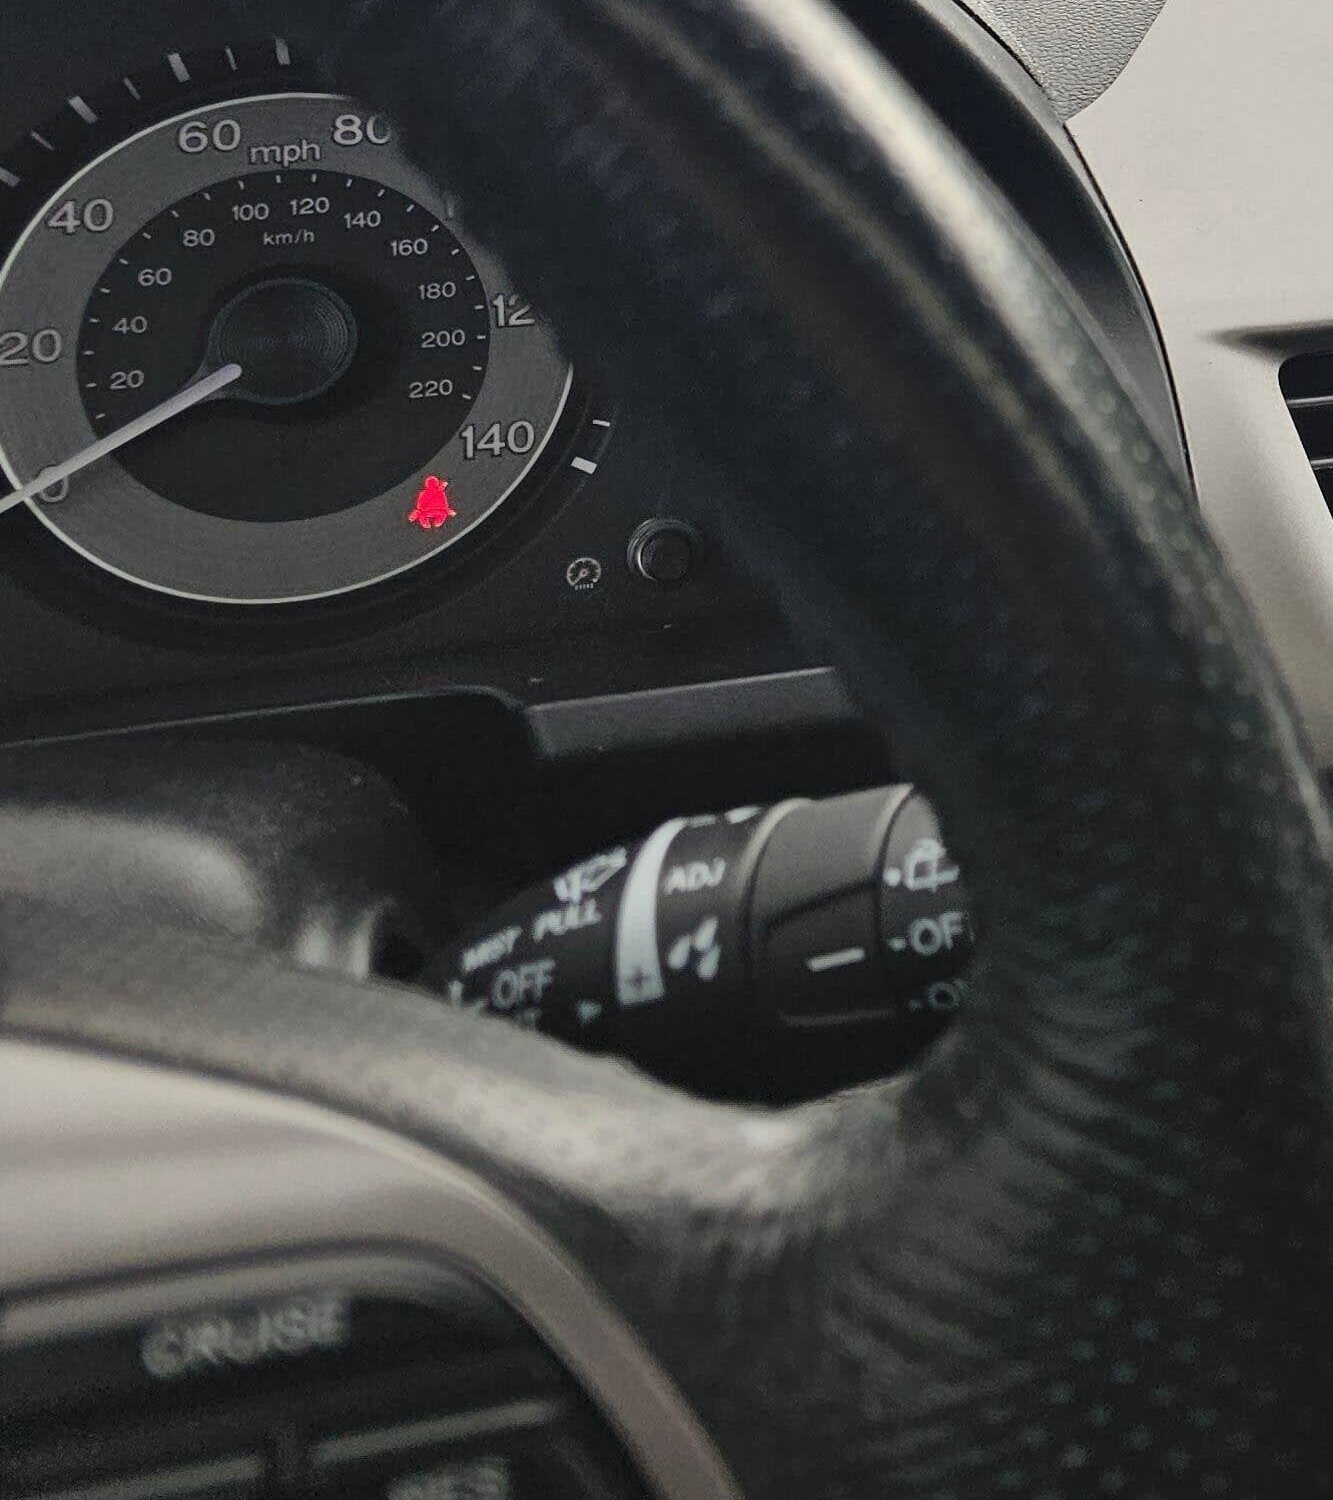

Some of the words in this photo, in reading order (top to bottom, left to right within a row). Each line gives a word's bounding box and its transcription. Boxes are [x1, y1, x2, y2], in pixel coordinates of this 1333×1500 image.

[178, 119, 242, 153] 60
[332, 113, 392, 146] 80
[249, 139, 322, 167] mph
[47, 198, 114, 233] 40
[231, 203, 270, 221] 100
[290, 196, 330, 215] 120
[343, 210, 381, 229] 140
[182, 228, 215, 247] 80
[263, 228, 315, 246] km/h
[390, 238, 428, 257] 160
[138, 267, 173, 286] 60
[417, 281, 456, 300] 180
[492, 293, 536, 327] 12
[112, 315, 148, 335] 40
[0, 329, 62, 366] 20
[421, 328, 466, 348] 200
[109, 369, 145, 390] 20
[408, 379, 453, 400] 220
[460, 420, 535, 459] 140
[492, 957, 556, 1010] OFF
